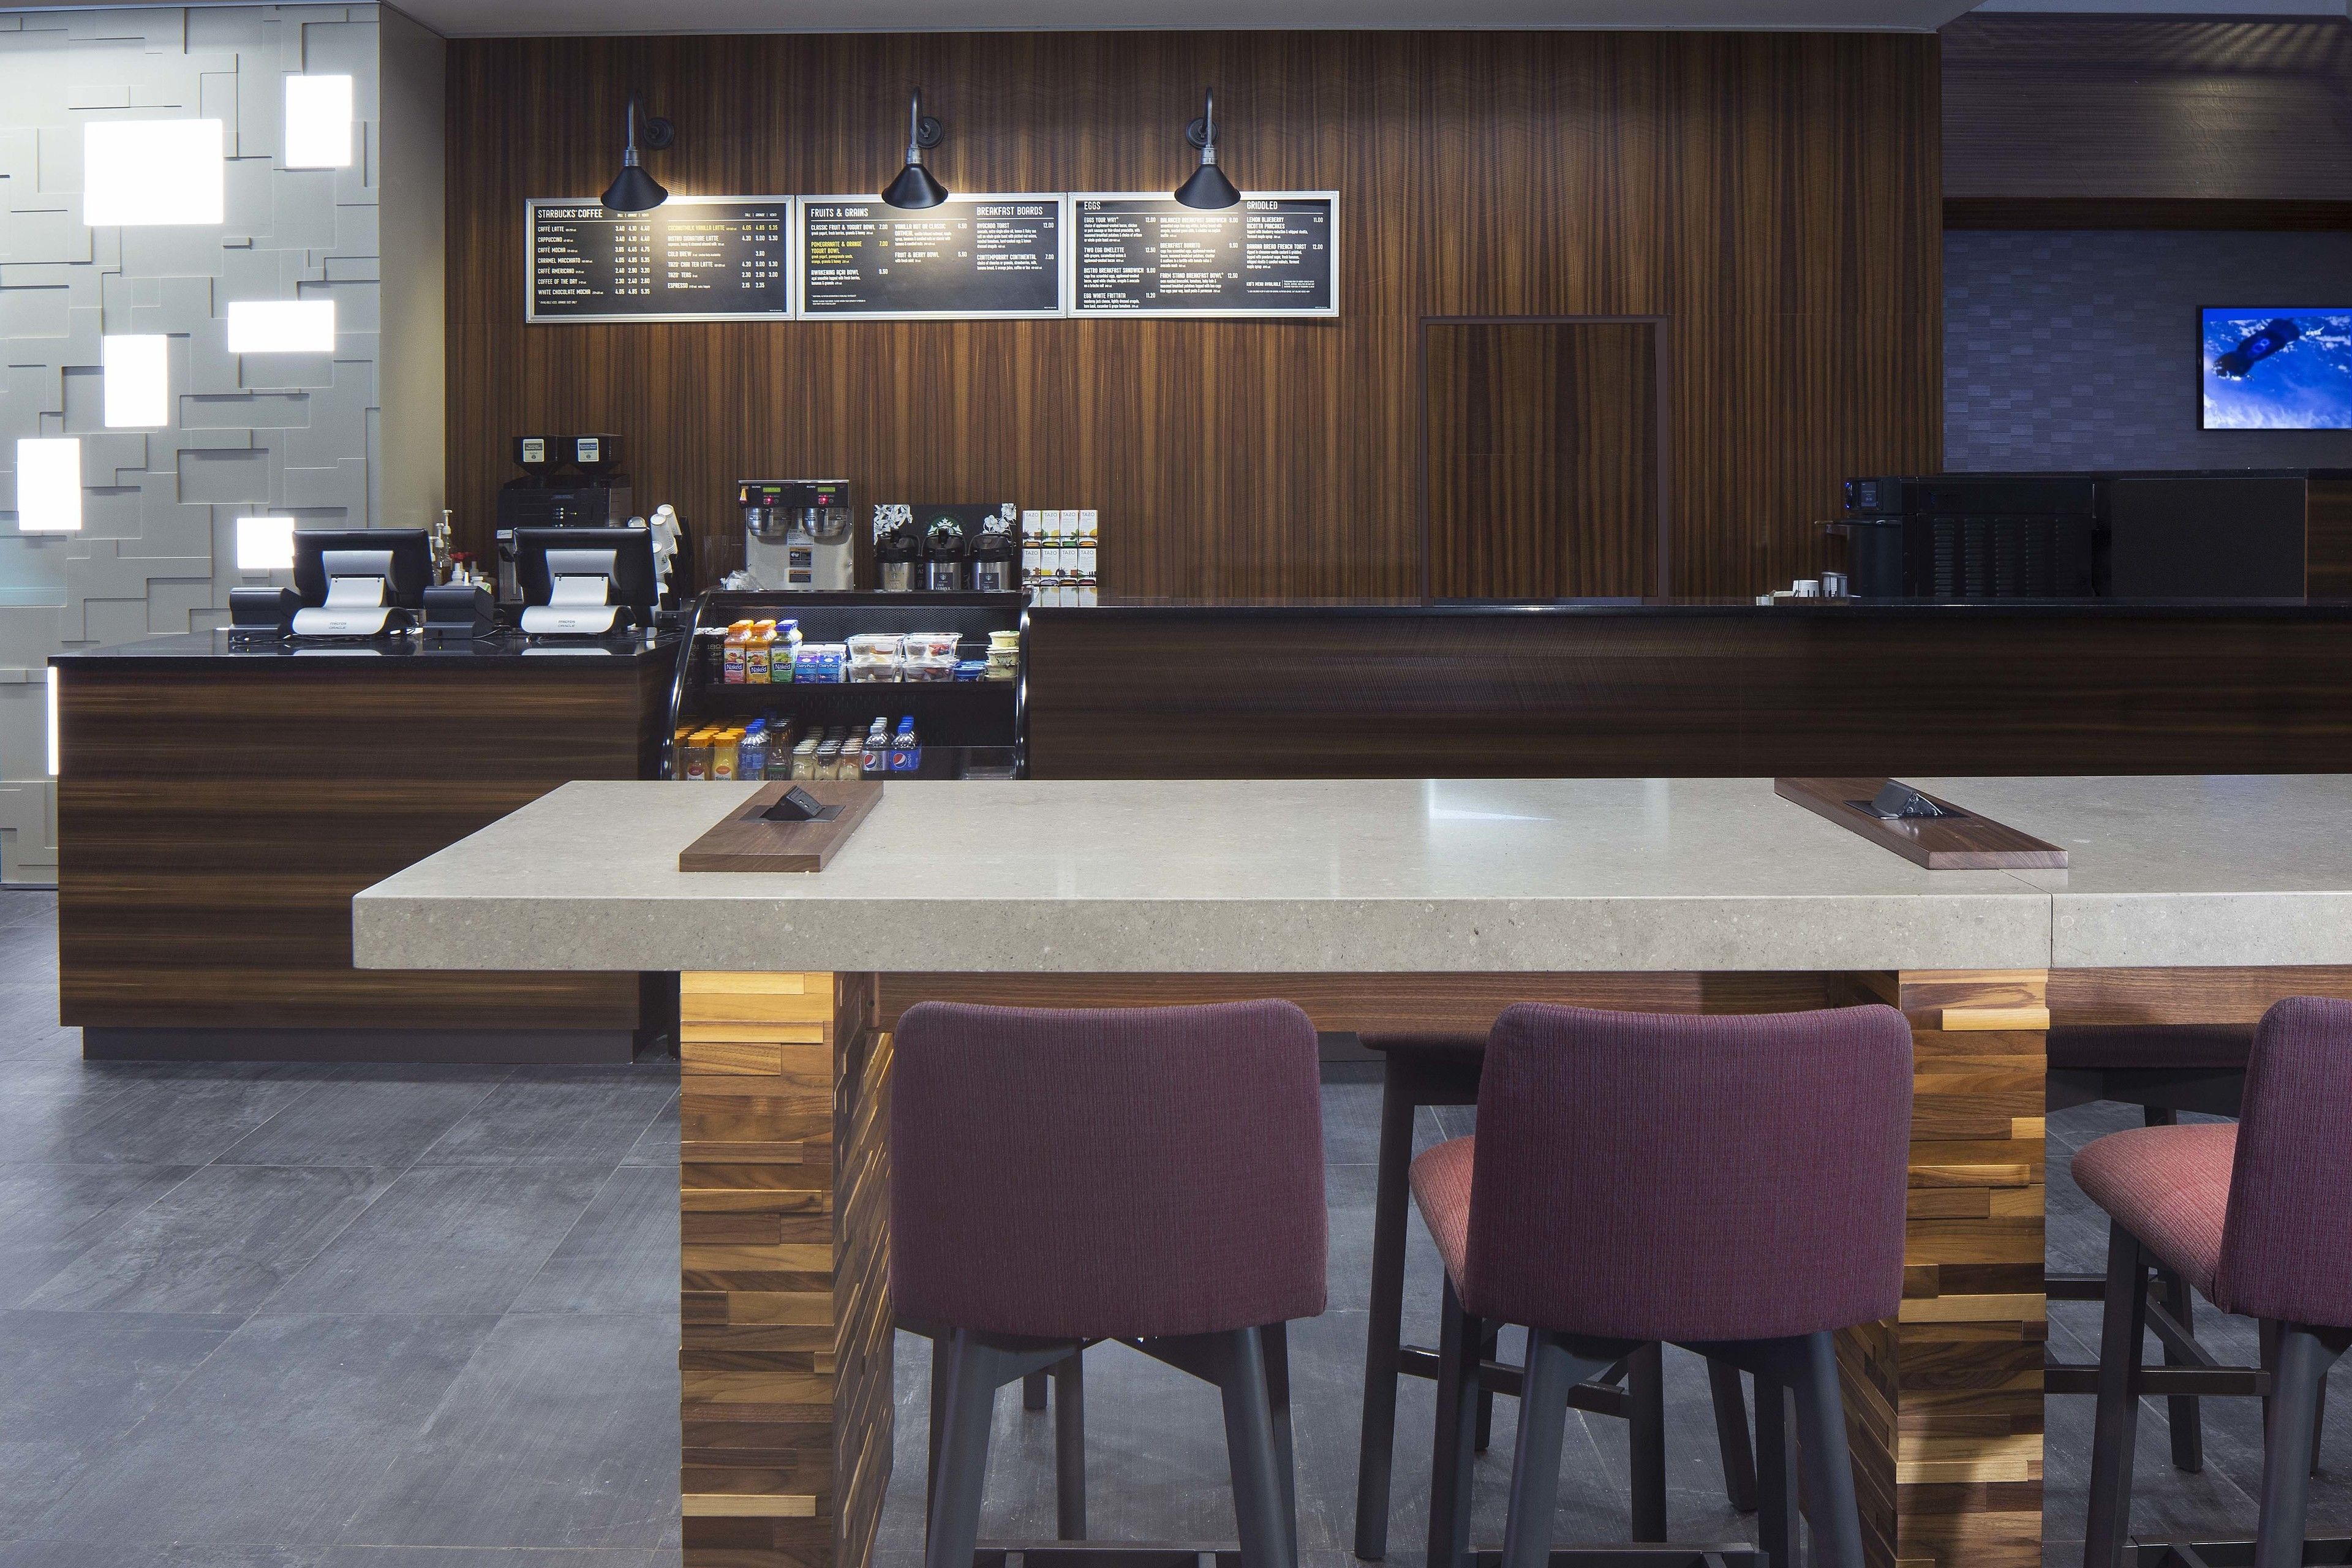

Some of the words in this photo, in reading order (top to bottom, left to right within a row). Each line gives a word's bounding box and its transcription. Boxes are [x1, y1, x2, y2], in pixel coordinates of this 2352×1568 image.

[1084, 201, 1101, 211] EGGS
[1246, 201, 1278, 210] GRIDDLED
[578, 208, 603, 218] COFFEE
[810, 208, 834, 217] FRUITS
[836, 208, 843, 217] &
[845, 208, 869, 217] GRAINS
[976, 206, 1015, 216] BREAKFAST
[1017, 206, 1043, 216] BOARDS
